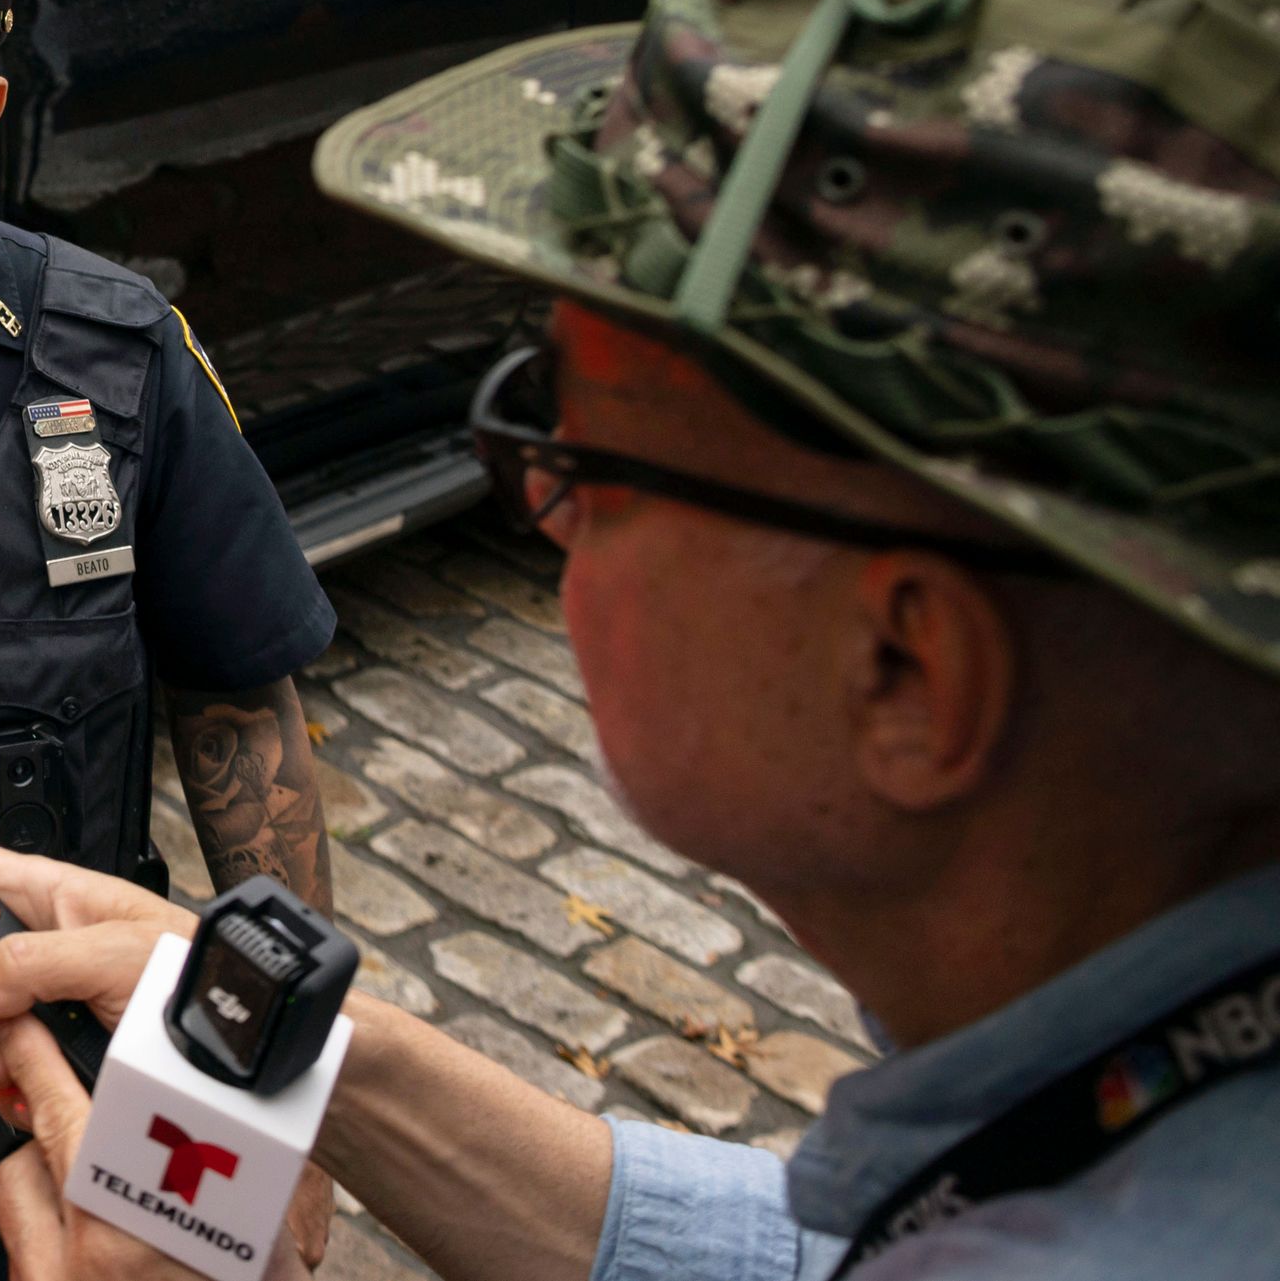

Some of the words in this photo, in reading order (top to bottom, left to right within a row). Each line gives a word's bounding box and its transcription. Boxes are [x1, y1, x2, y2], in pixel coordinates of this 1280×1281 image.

[56, 500, 115, 533] 13326
[77, 558, 110, 576] BEATO
[90, 1164, 255, 1261] TELEMUNDO
